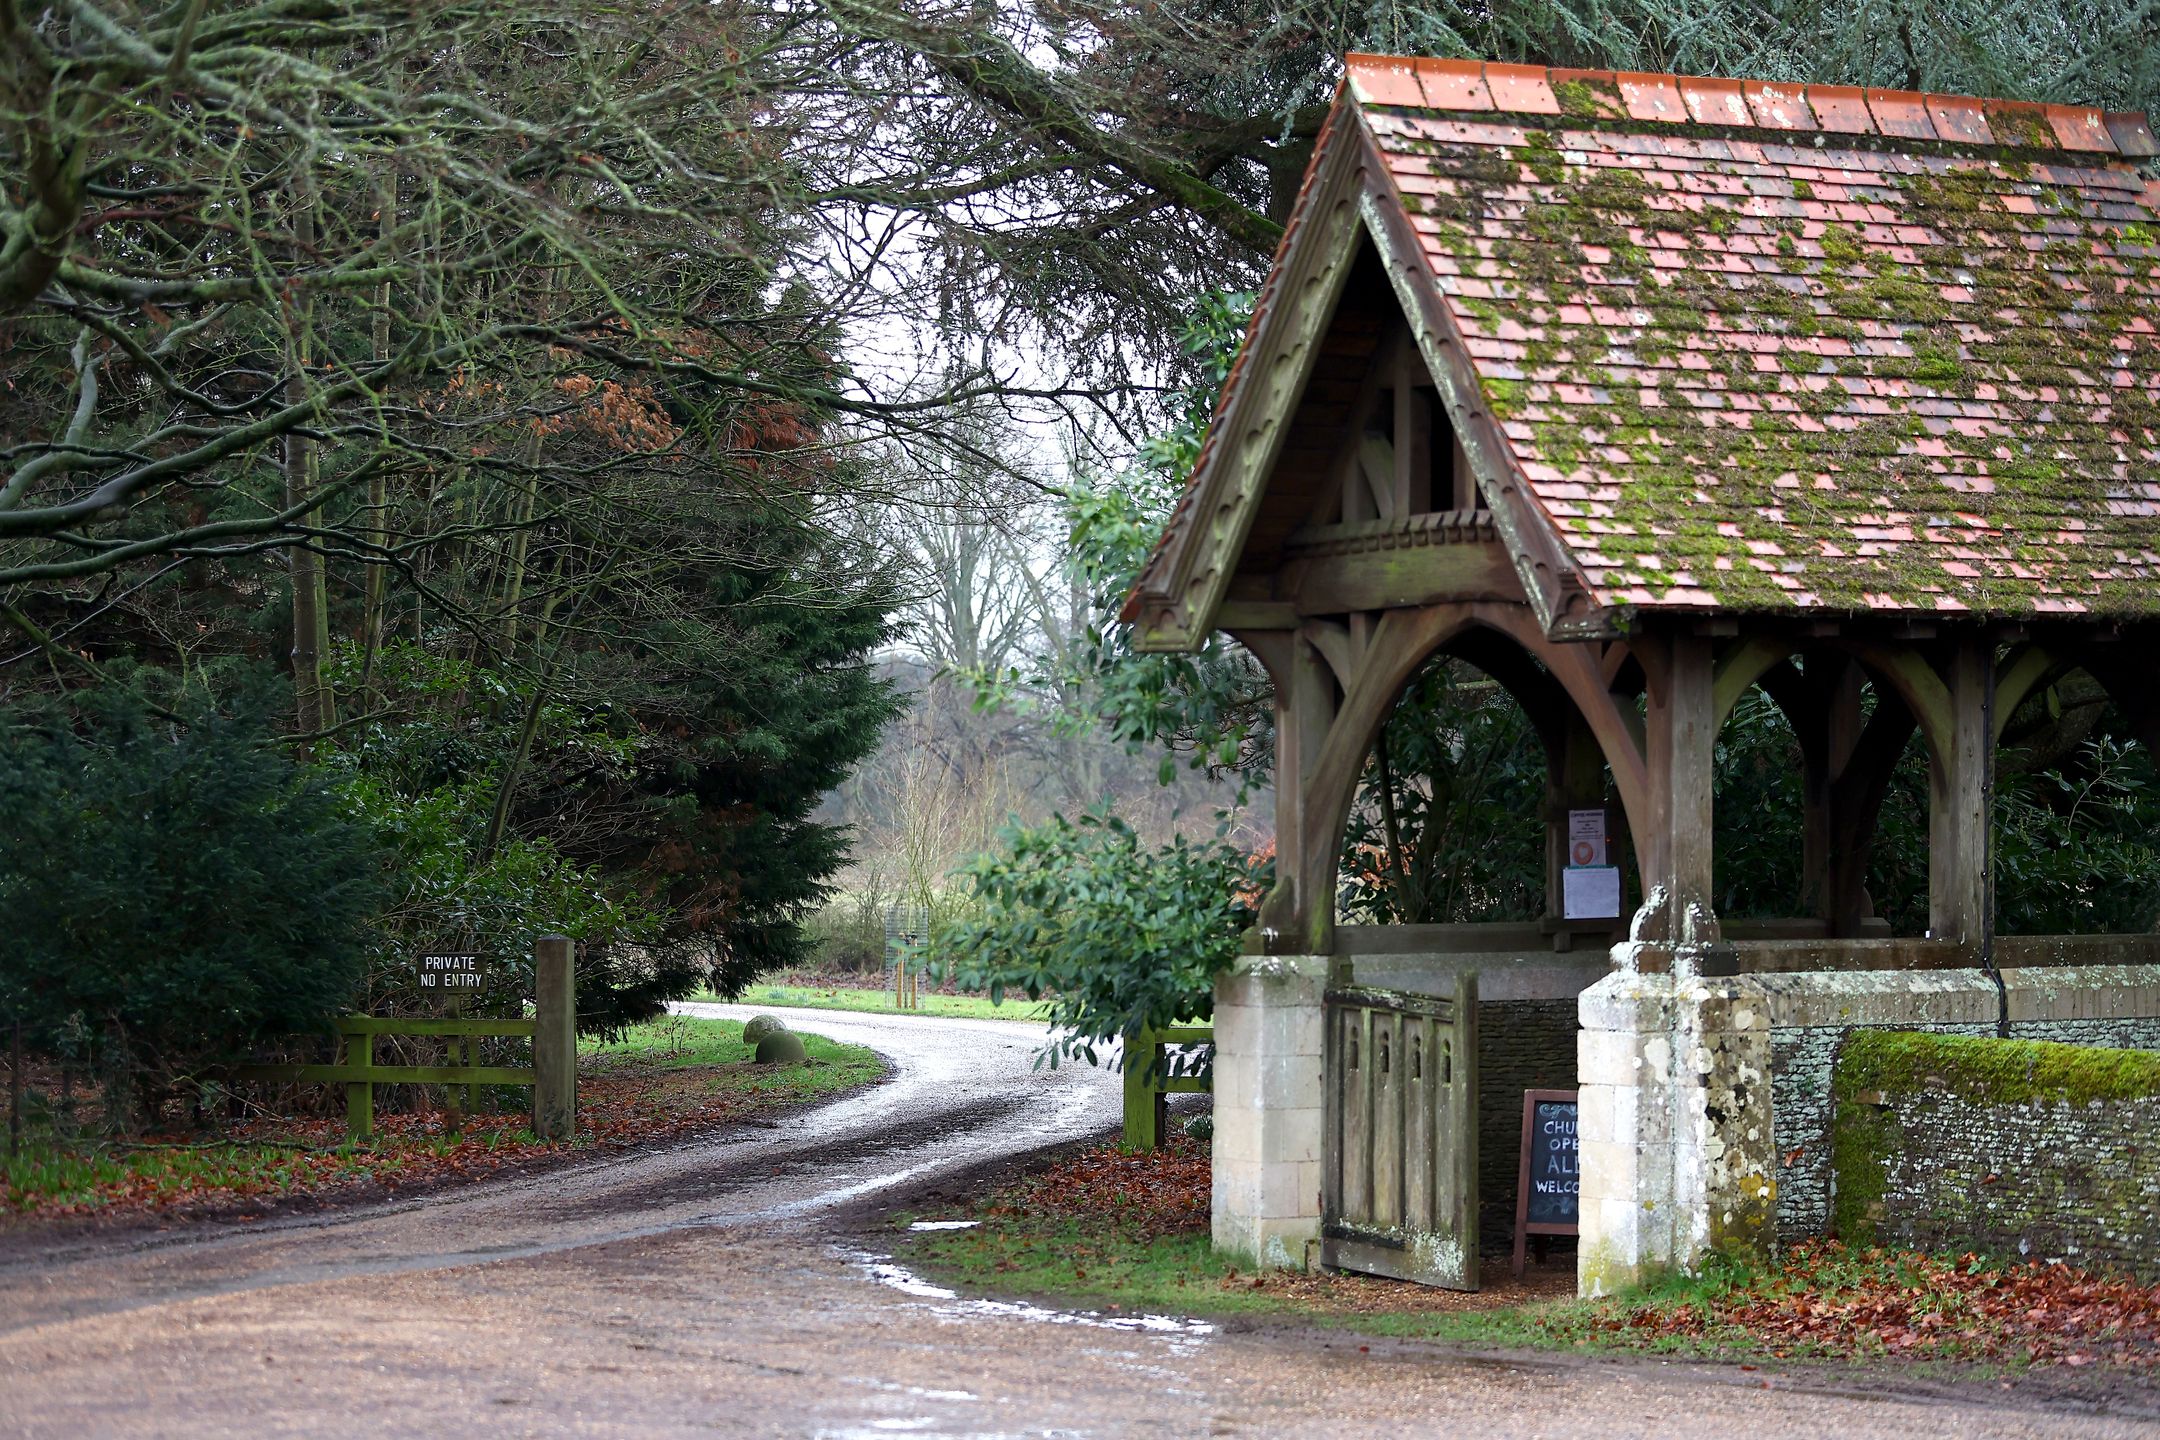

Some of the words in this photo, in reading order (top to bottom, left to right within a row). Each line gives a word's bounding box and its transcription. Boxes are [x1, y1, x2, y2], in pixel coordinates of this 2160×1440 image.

[425, 956, 476, 970] PRIVATE
[420, 973, 436, 987] NO
[444, 973, 482, 987] ENTRY
[1543, 1120, 1578, 1135] CHU
[1549, 1137, 1580, 1151] OPE
[1536, 1180, 1580, 1194] WELCO
